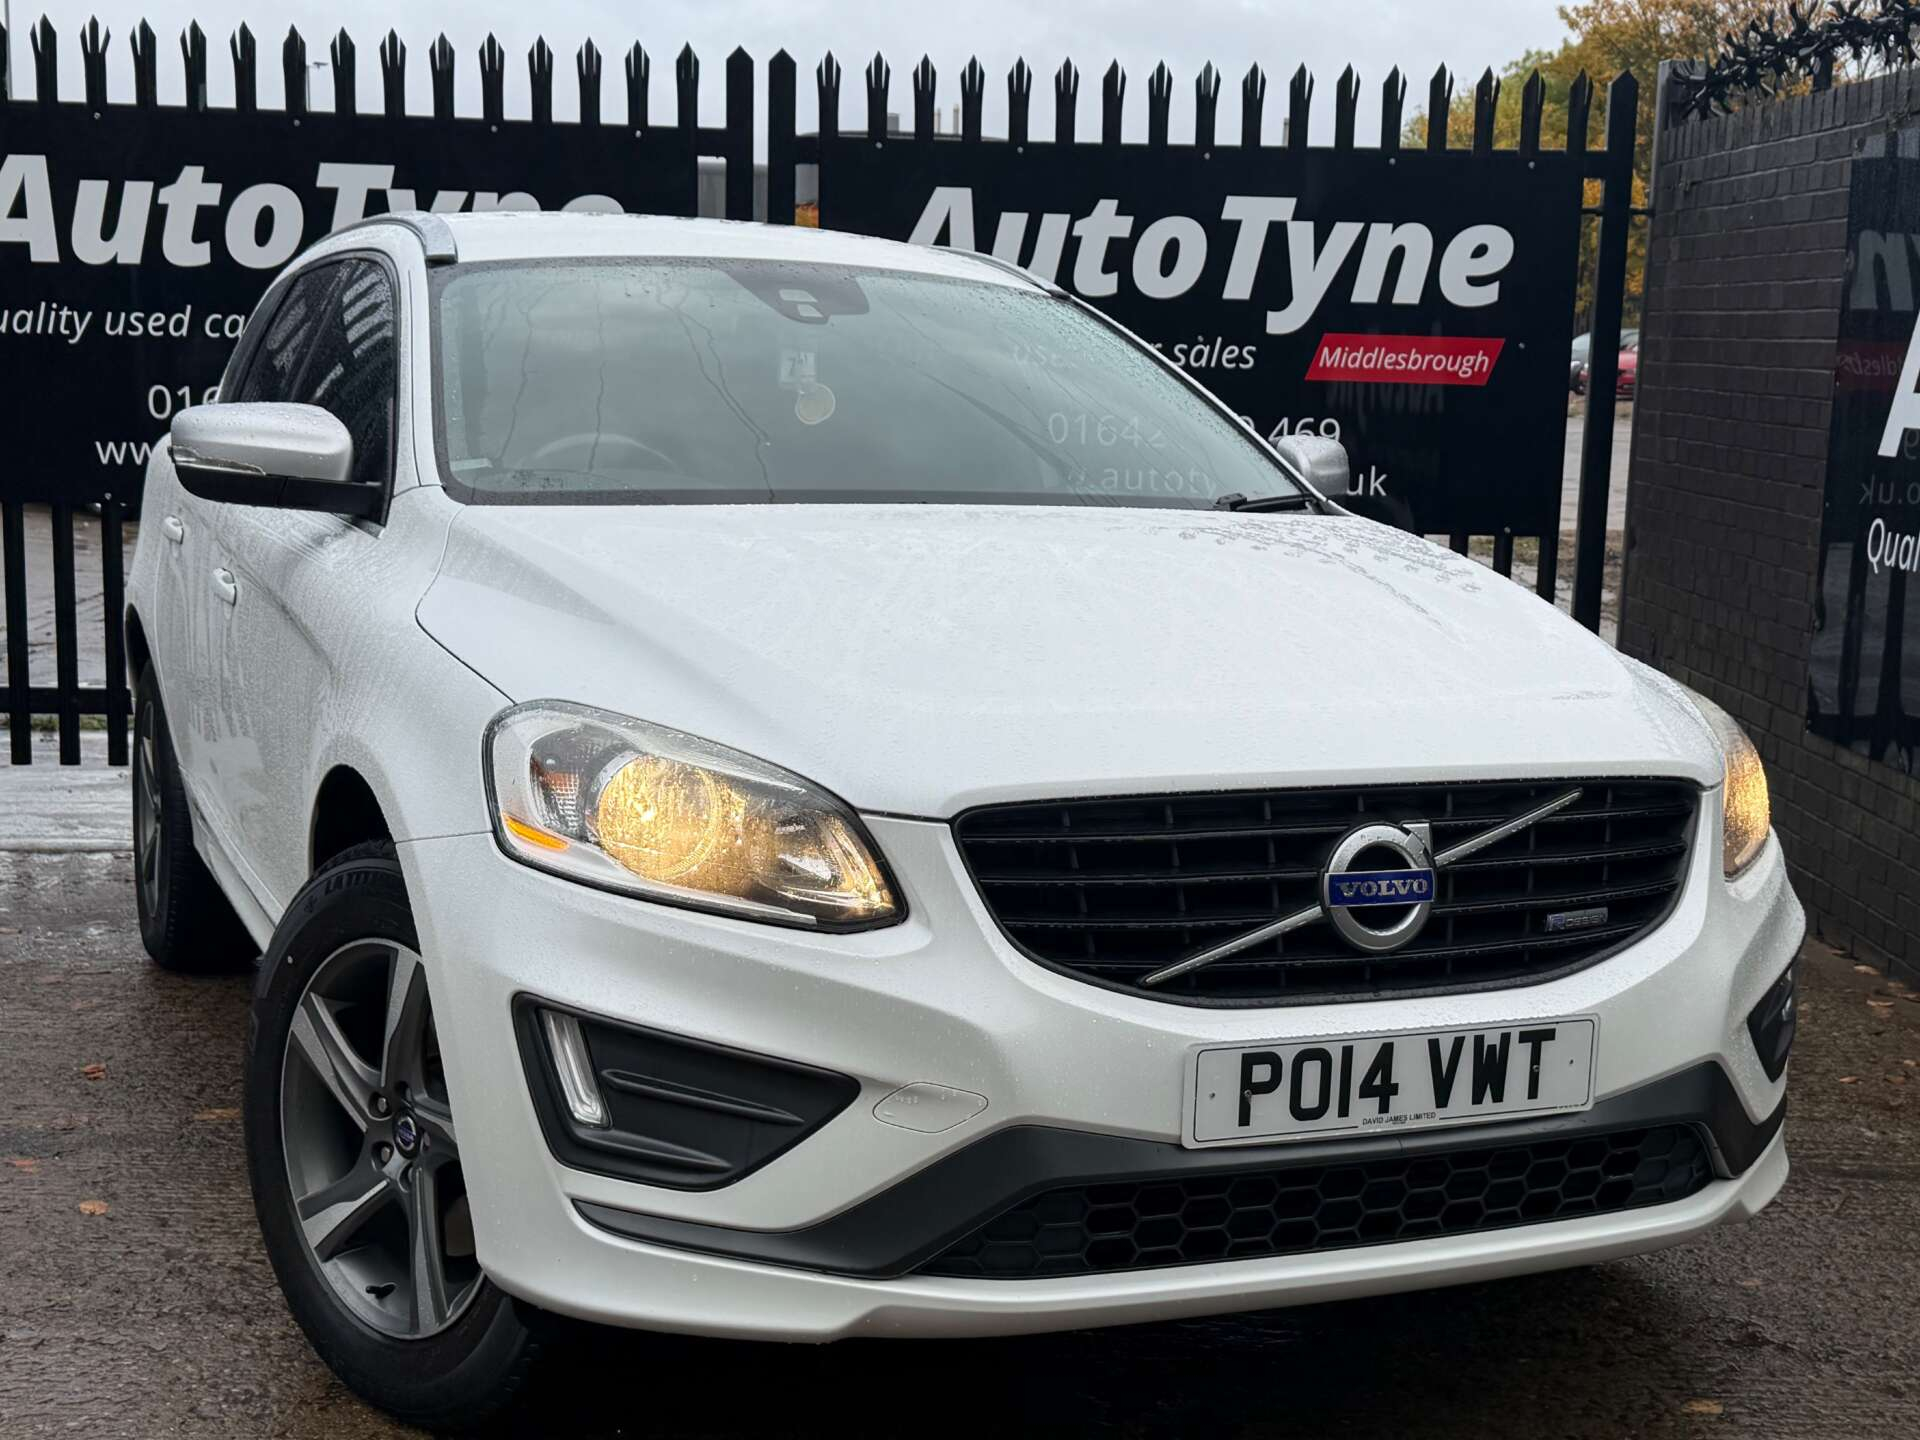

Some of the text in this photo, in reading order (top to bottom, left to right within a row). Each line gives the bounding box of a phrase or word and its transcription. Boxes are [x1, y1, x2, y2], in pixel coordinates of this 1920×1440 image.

[104, 304, 192, 337] used
[1173, 336, 1257, 369] sales
[1318, 346, 1490, 379] Middlesbrough
[1336, 878, 1428, 897] VOLVO
[1427, 1028, 1557, 1109] VWT
[1362, 1117, 1384, 1126] DAVID
[1385, 1114, 1408, 1123] JAMES
[1409, 1111, 1437, 1121] LIMITED
